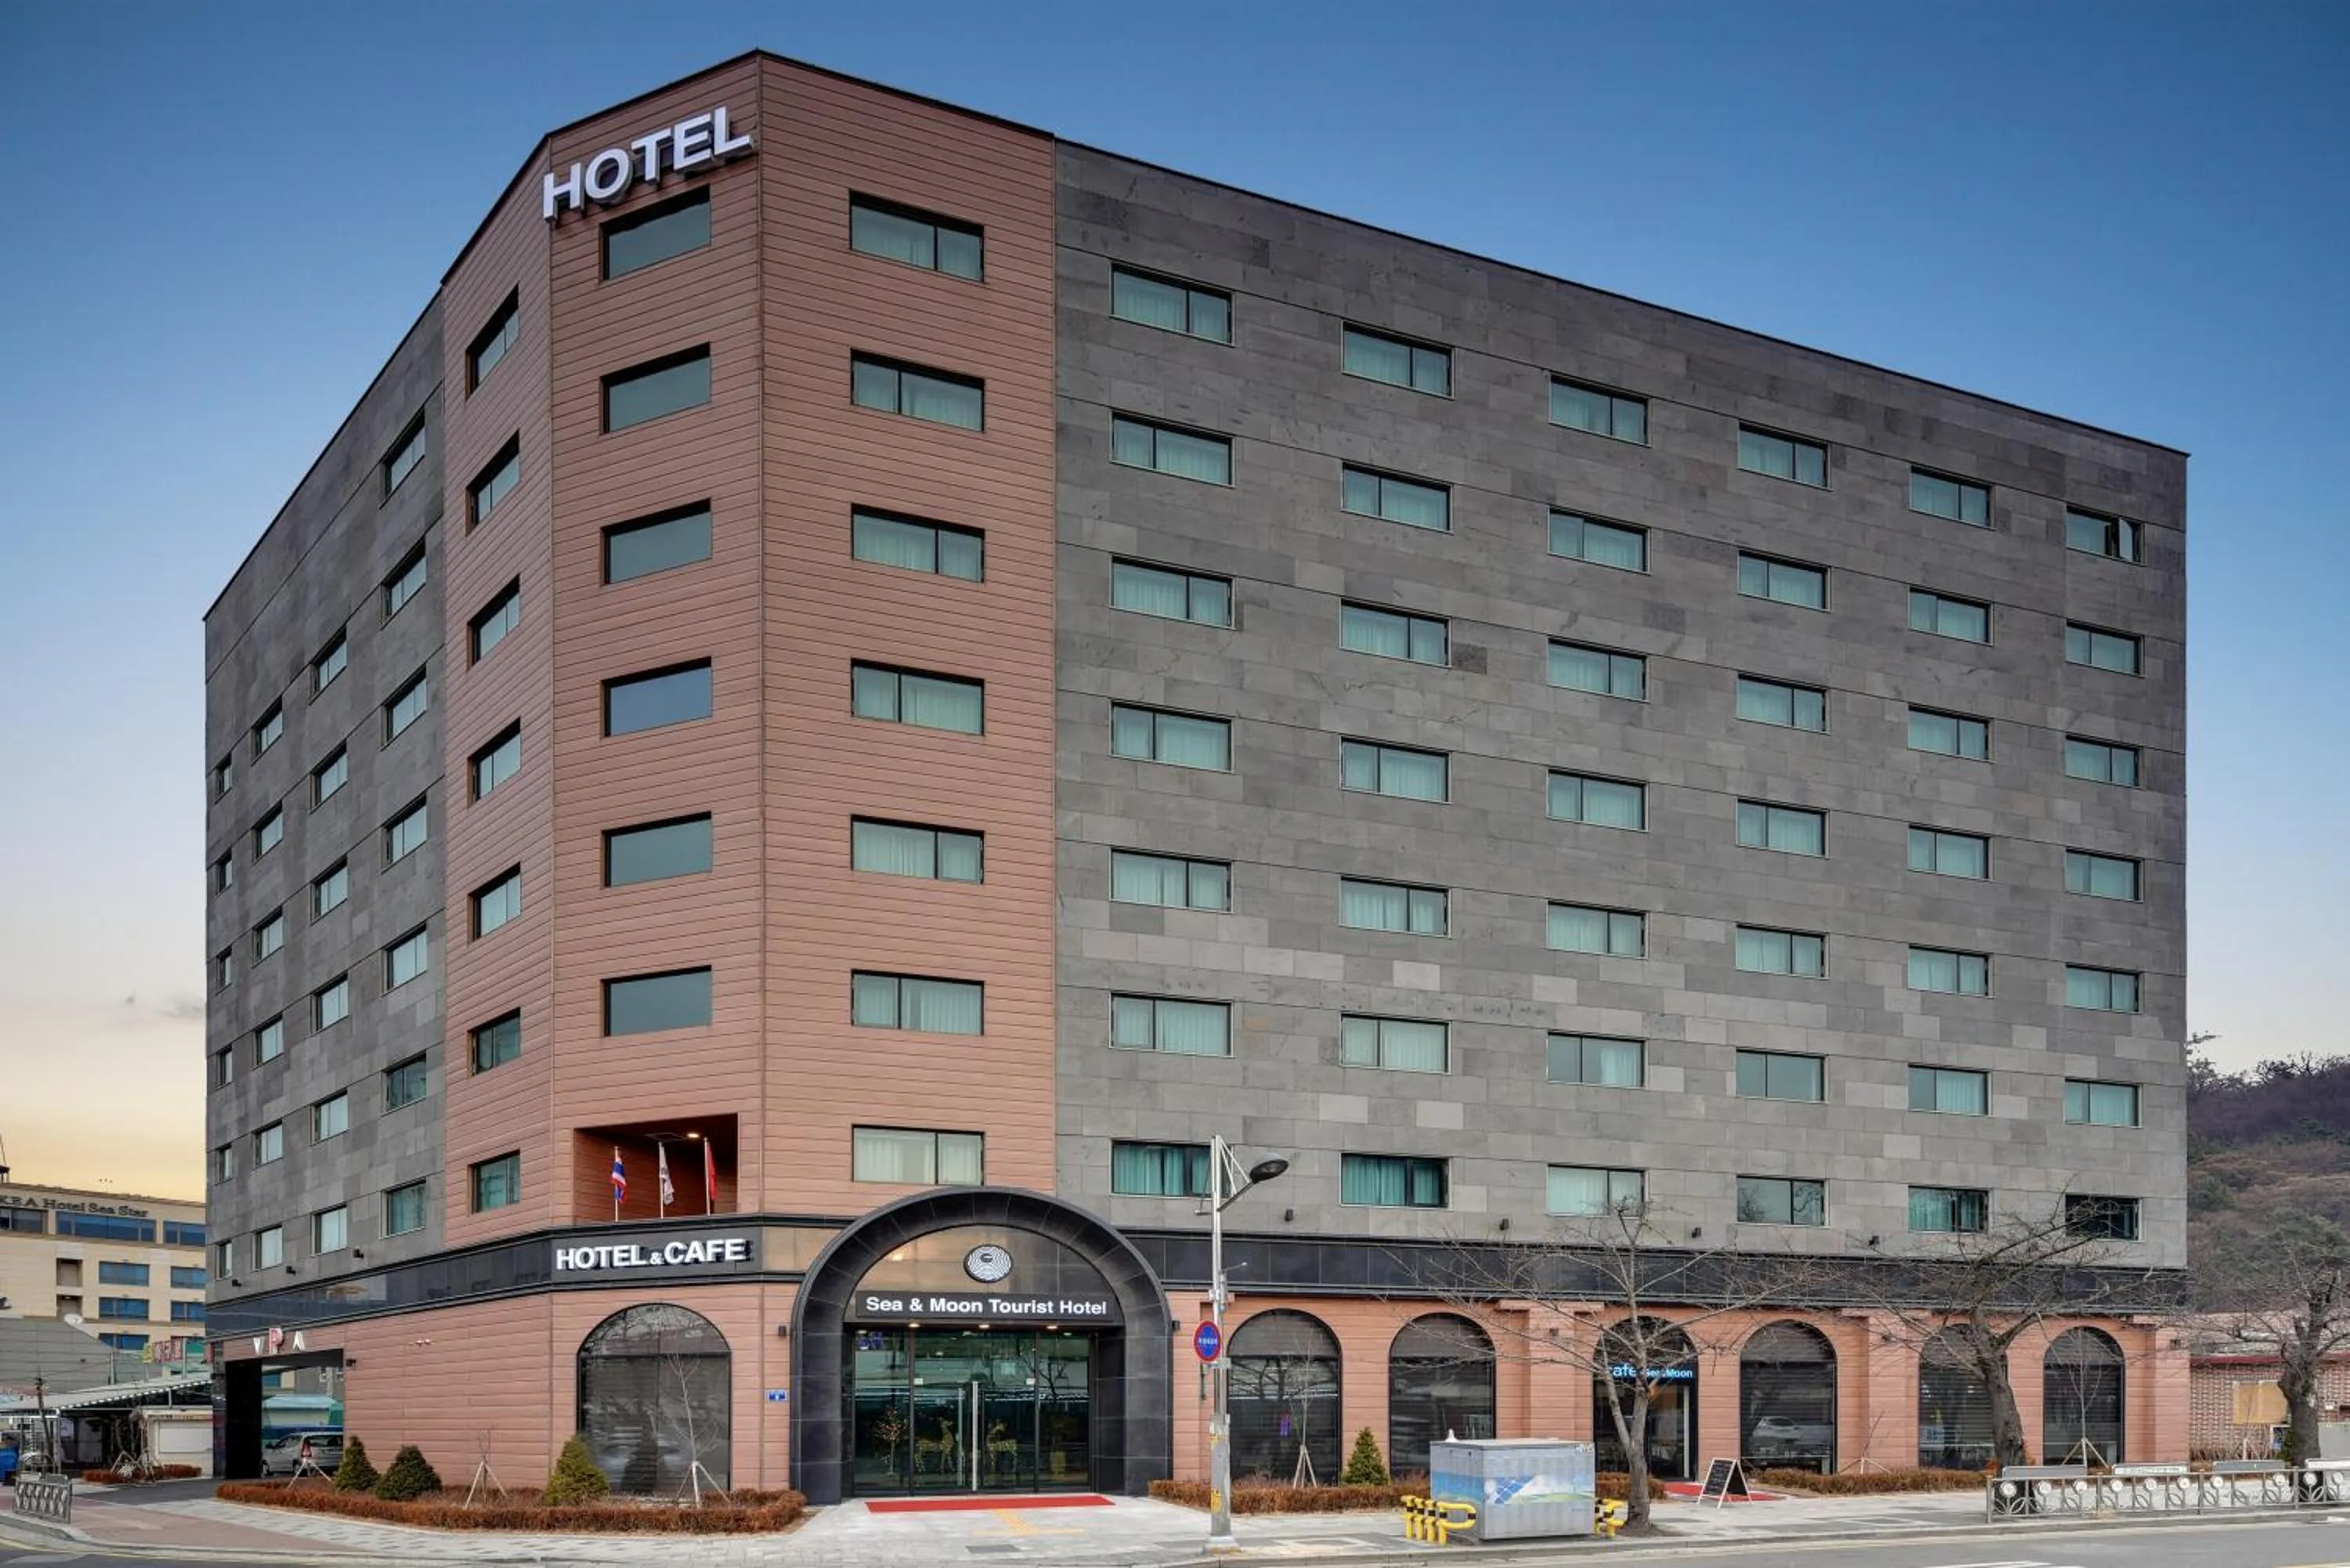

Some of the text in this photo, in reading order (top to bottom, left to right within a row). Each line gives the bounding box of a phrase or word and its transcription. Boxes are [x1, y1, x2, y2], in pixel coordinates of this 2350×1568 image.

[543, 106, 753, 220] HOTEL
[44, 1198, 85, 1211] Hotel
[89, 1202, 115, 1213] Sea
[118, 1205, 149, 1217] Star
[866, 1296, 1107, 1315] Sea & Moon Tourist Hotel
